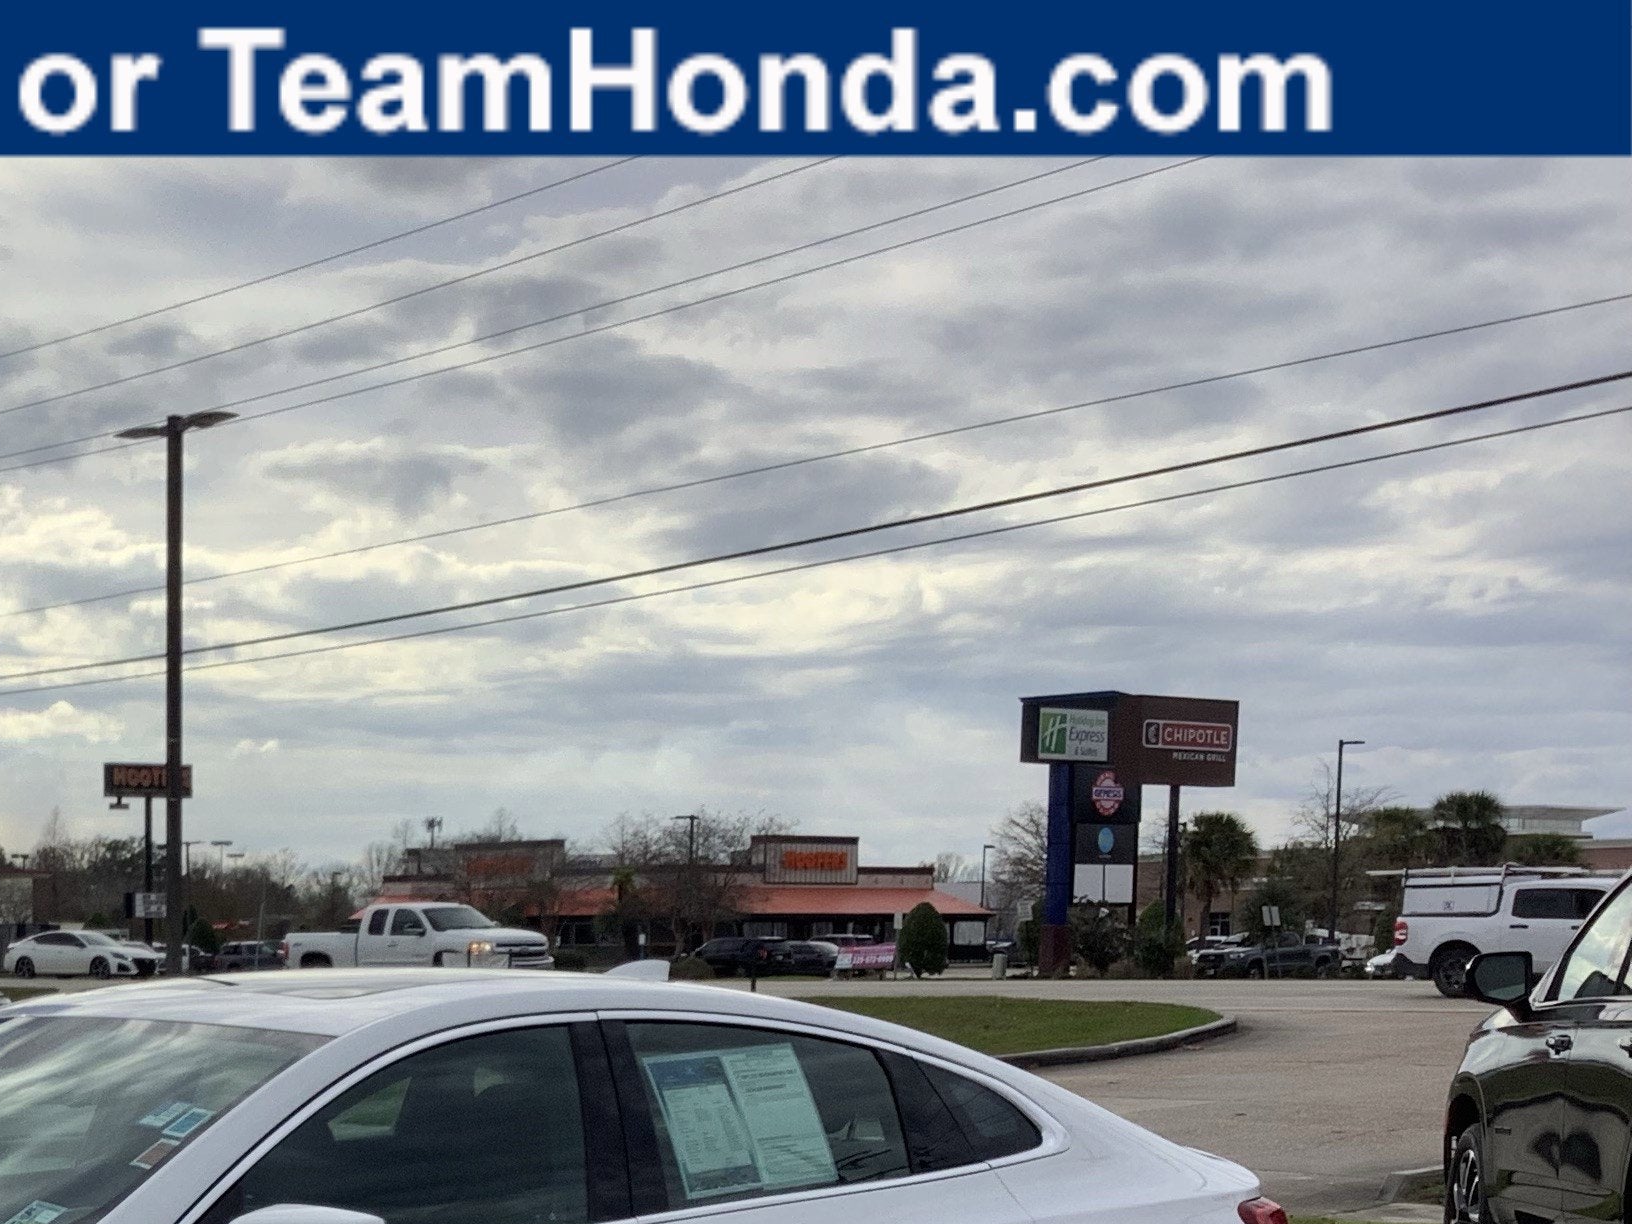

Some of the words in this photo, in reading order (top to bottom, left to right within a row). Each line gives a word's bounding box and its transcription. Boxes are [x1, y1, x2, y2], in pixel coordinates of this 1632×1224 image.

[1069, 726, 1105, 745] Express
[1164, 727, 1229, 745] CHIPOTLE
[1172, 752, 1205, 762] MEXICAN
[1206, 754, 1226, 763] GRILL
